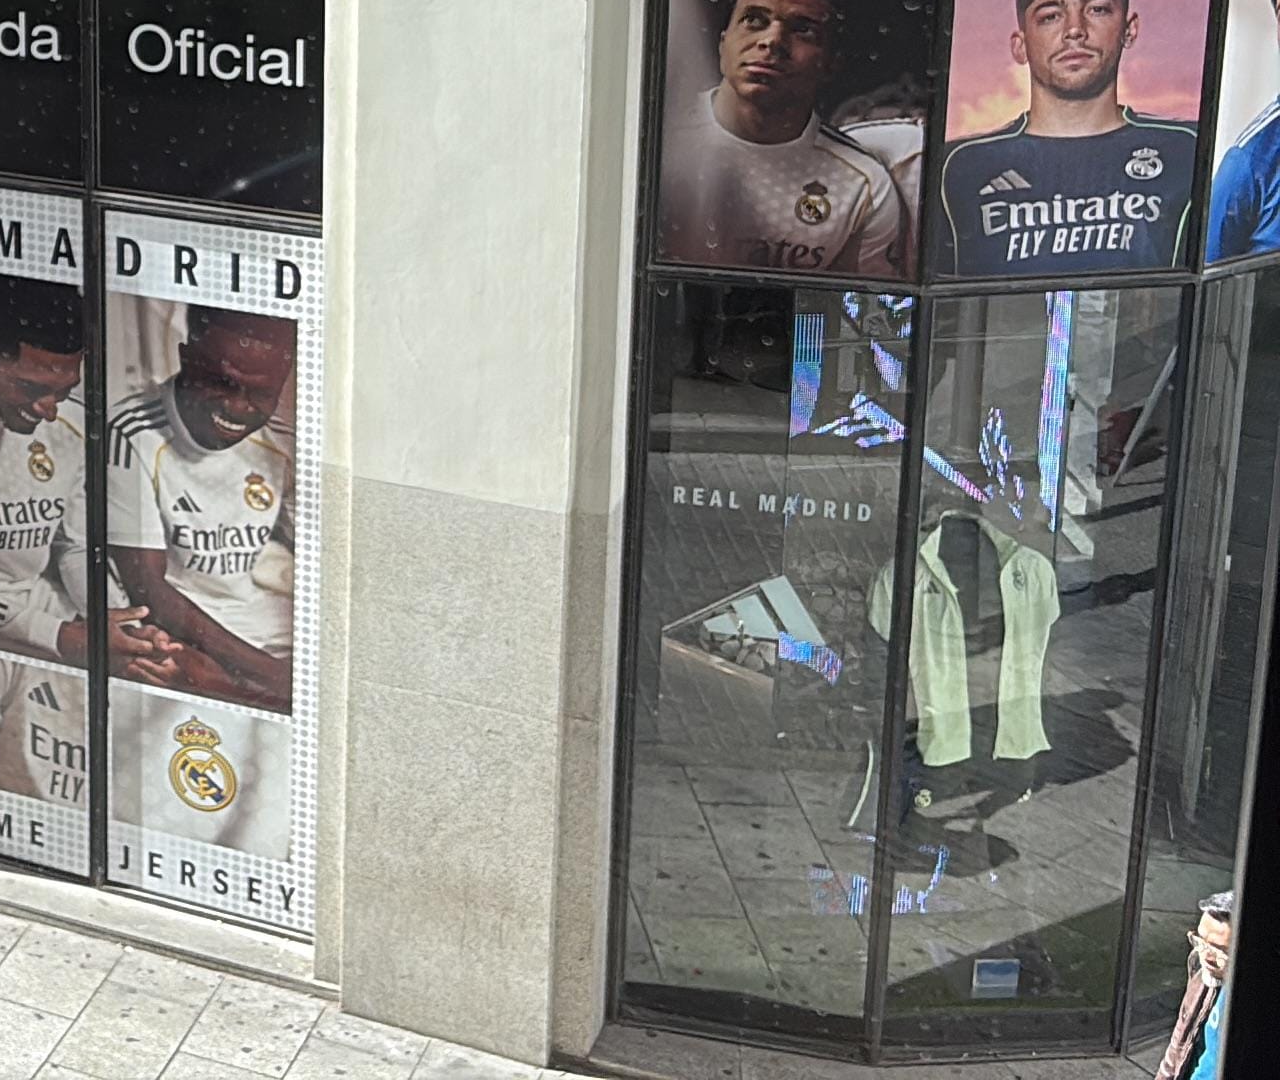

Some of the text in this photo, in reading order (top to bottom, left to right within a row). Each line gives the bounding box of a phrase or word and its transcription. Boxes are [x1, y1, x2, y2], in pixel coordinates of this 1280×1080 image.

[127, 24, 305, 87] Oficial
[980, 190, 1162, 236] Emirates
[1006, 222, 1134, 262] FLY BETTER
[673, 486, 872, 522] REAL MADRID
[186, 554, 217, 574] FLY
[30, 722, 86, 772] Em
[49, 770, 85, 803] FLY
[119, 845, 296, 912] JERSEY
